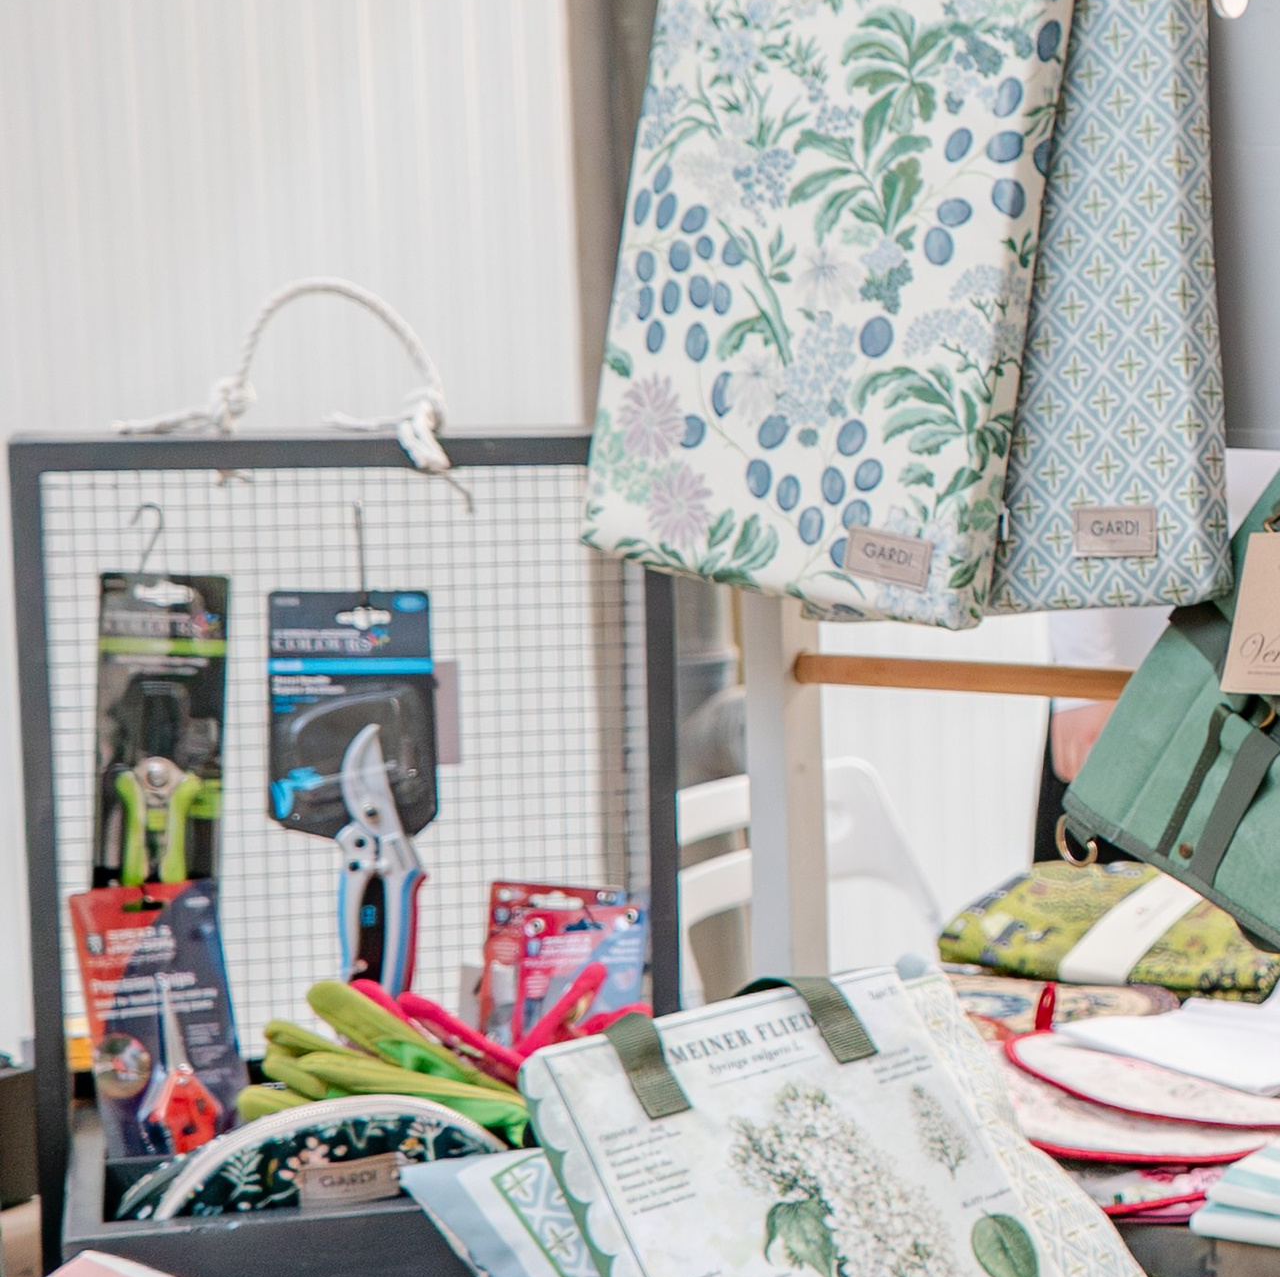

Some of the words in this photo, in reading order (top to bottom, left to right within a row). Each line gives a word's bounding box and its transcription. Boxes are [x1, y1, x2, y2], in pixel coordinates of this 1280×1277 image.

[1090, 519, 1140, 537] GARDI
[863, 542, 913, 566] GARDI
[667, 1026, 751, 1065] MEINER
